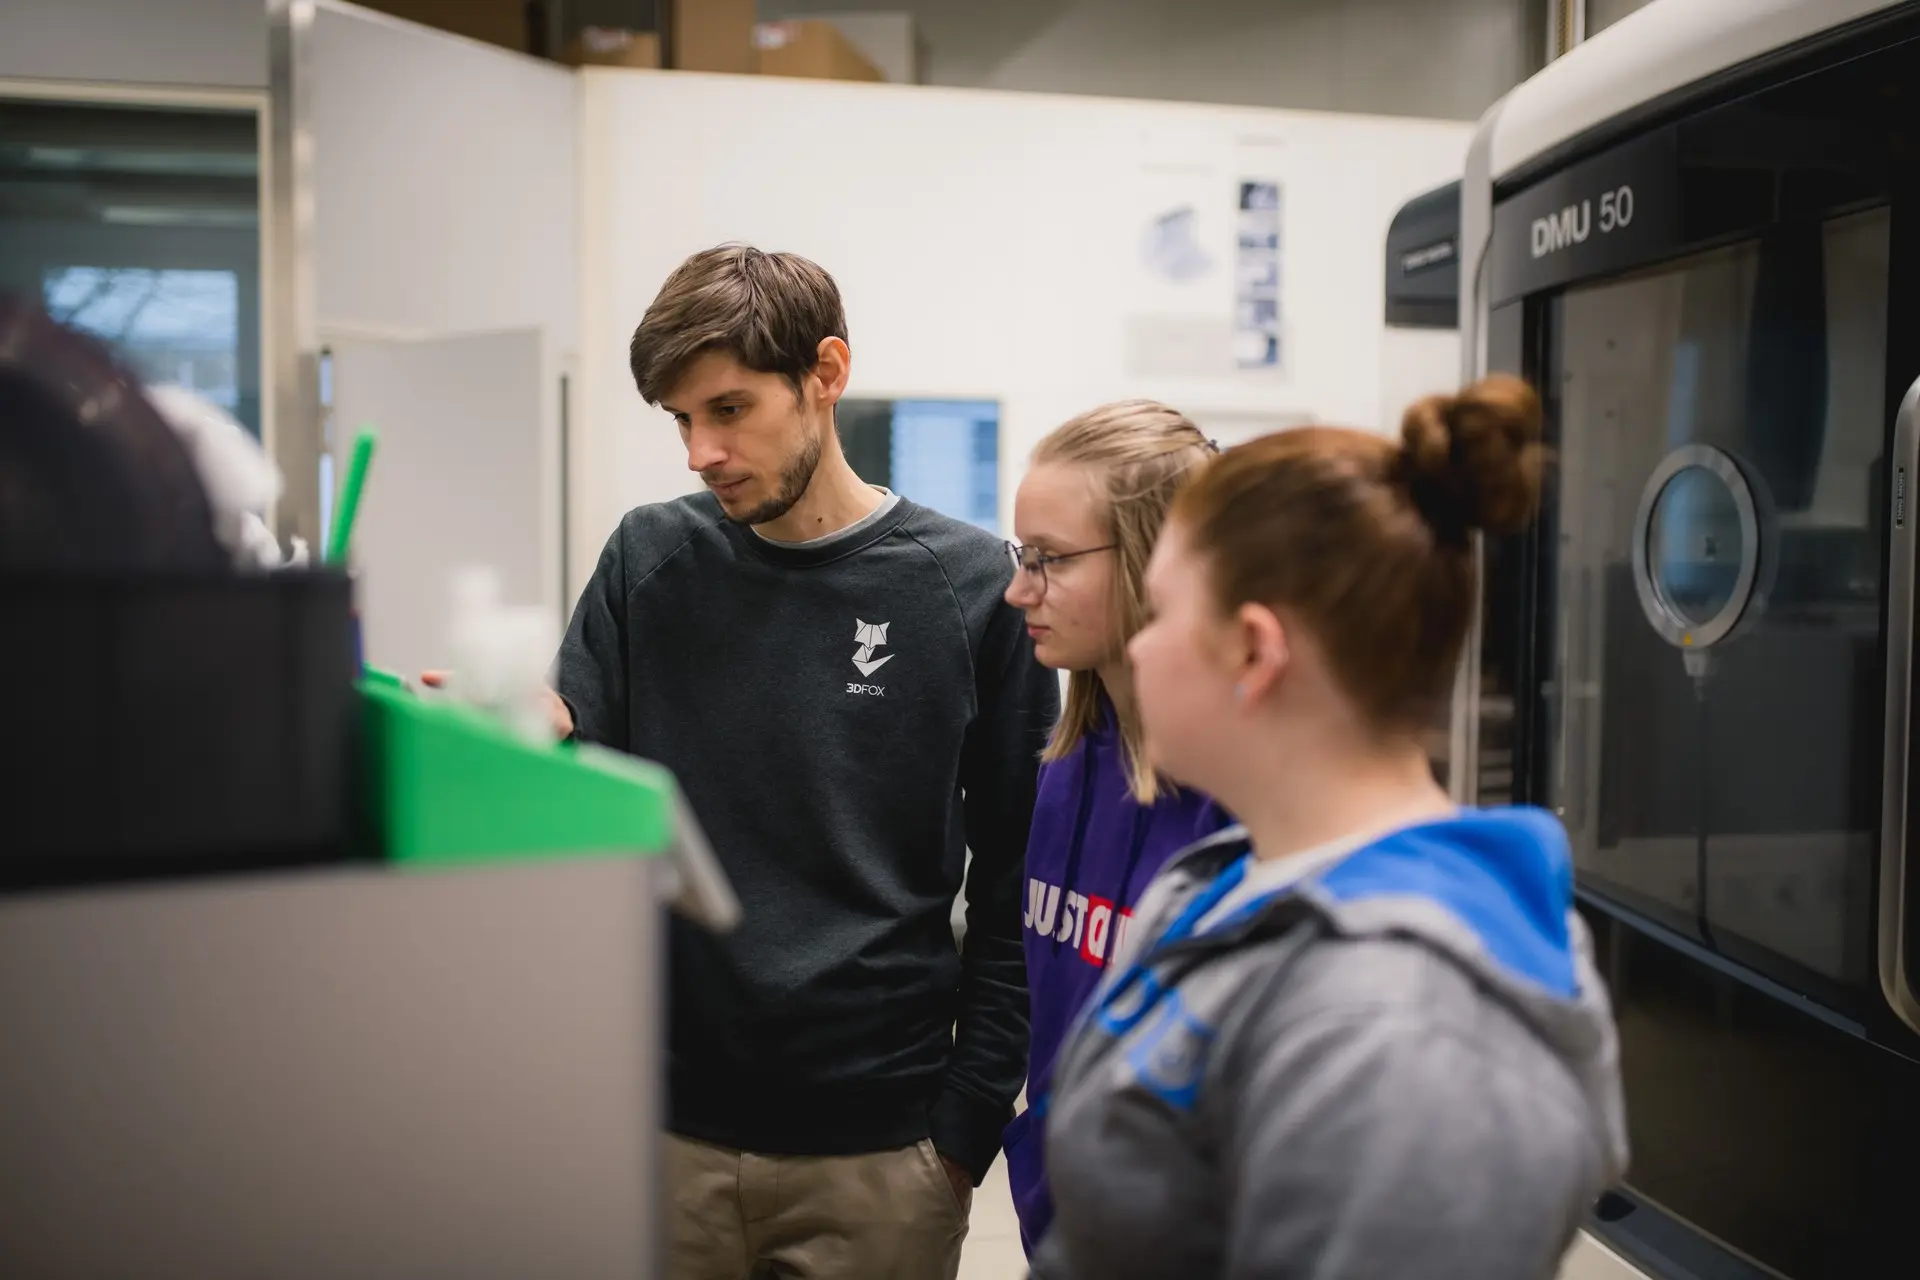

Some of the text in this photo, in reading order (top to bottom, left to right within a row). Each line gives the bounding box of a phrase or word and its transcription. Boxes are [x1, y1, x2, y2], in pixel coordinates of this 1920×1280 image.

[1530, 185, 1634, 259] DMU 50
[845, 682, 886, 697] 3DFOX
